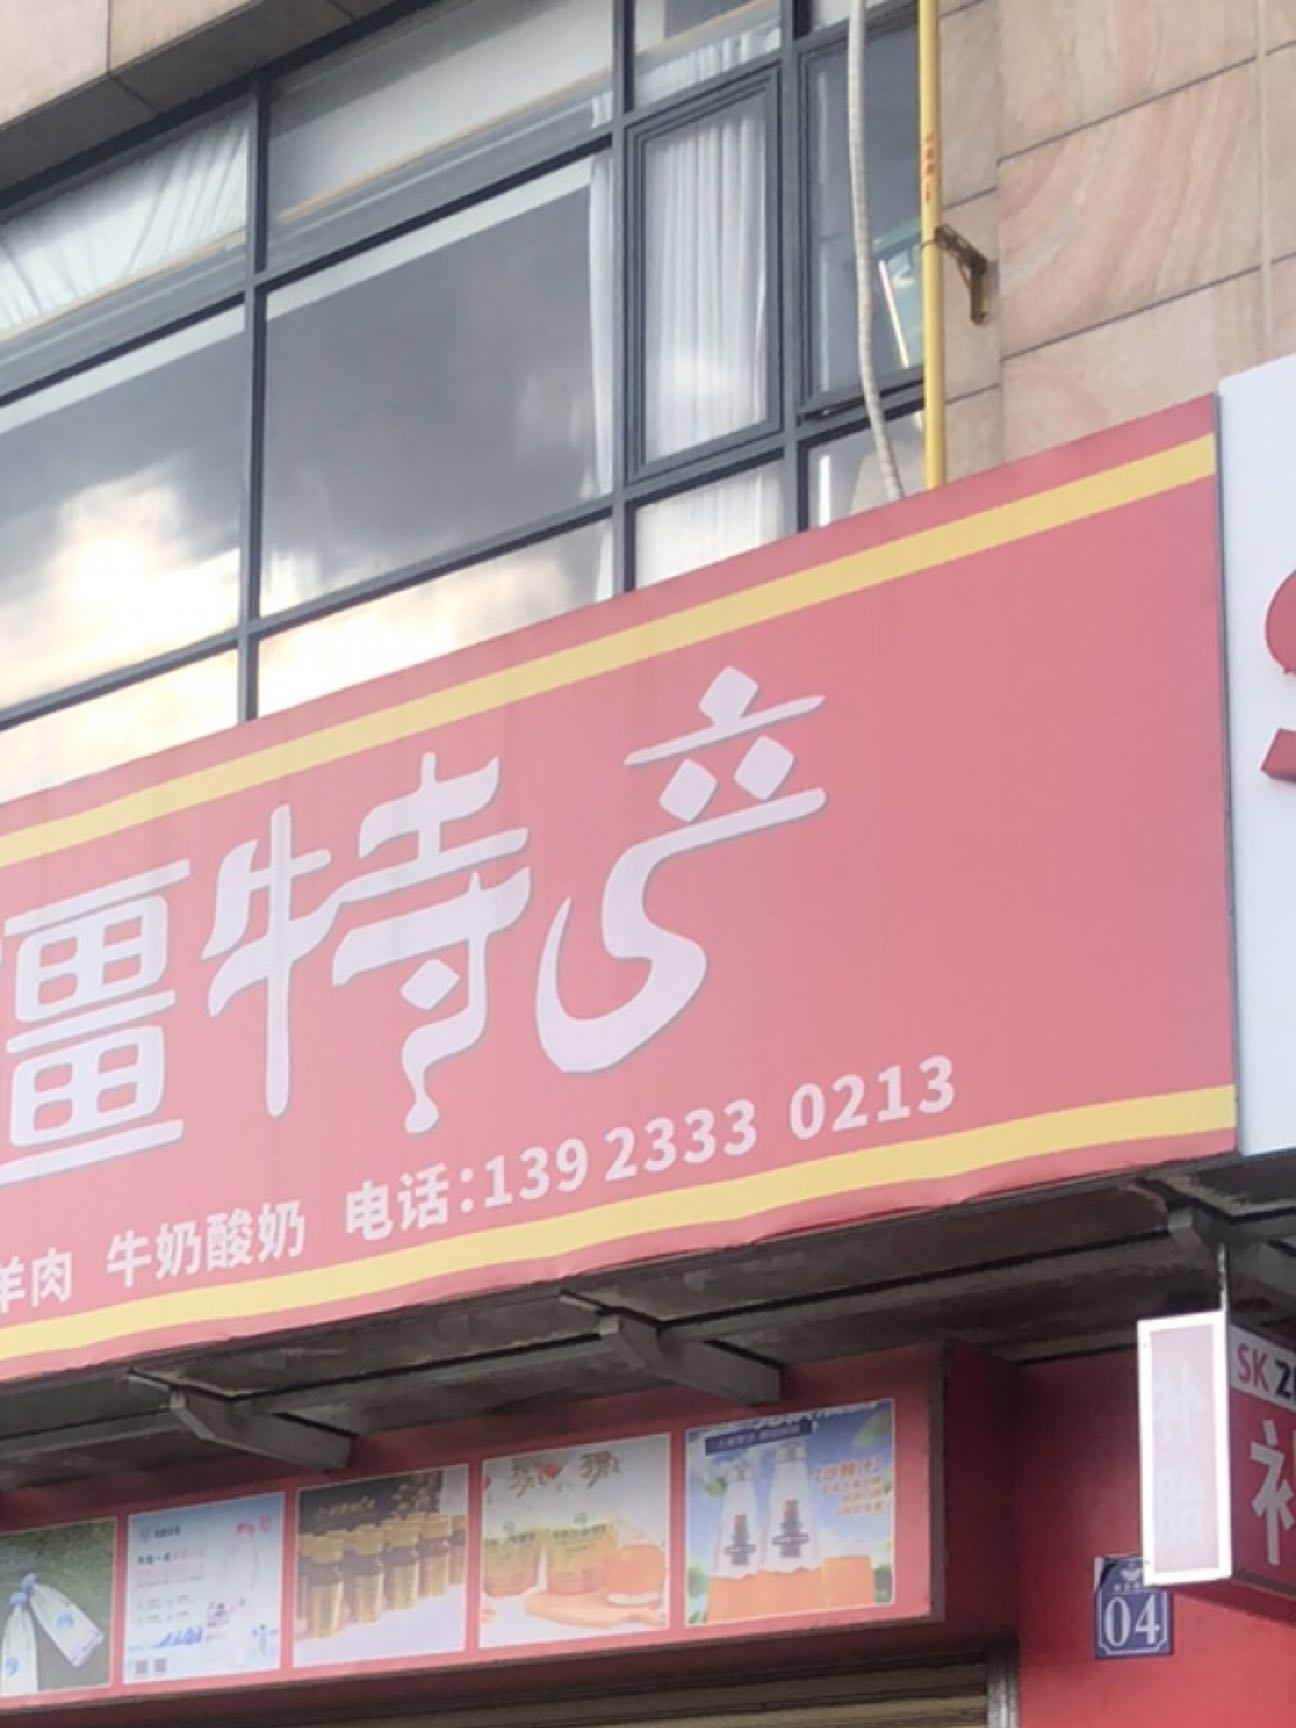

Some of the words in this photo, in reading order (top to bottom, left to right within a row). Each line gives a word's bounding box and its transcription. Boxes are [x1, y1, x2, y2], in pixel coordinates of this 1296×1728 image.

[604, 1099, 757, 1183] 2333
[789, 1055, 956, 1140] 0213
[106, 1200, 305, 1289] 牛奶酸奶
[1237, 1343, 1269, 1392] SK
[1274, 1358, 1296, 1400] 2
[1105, 1594, 1160, 1648] 04
